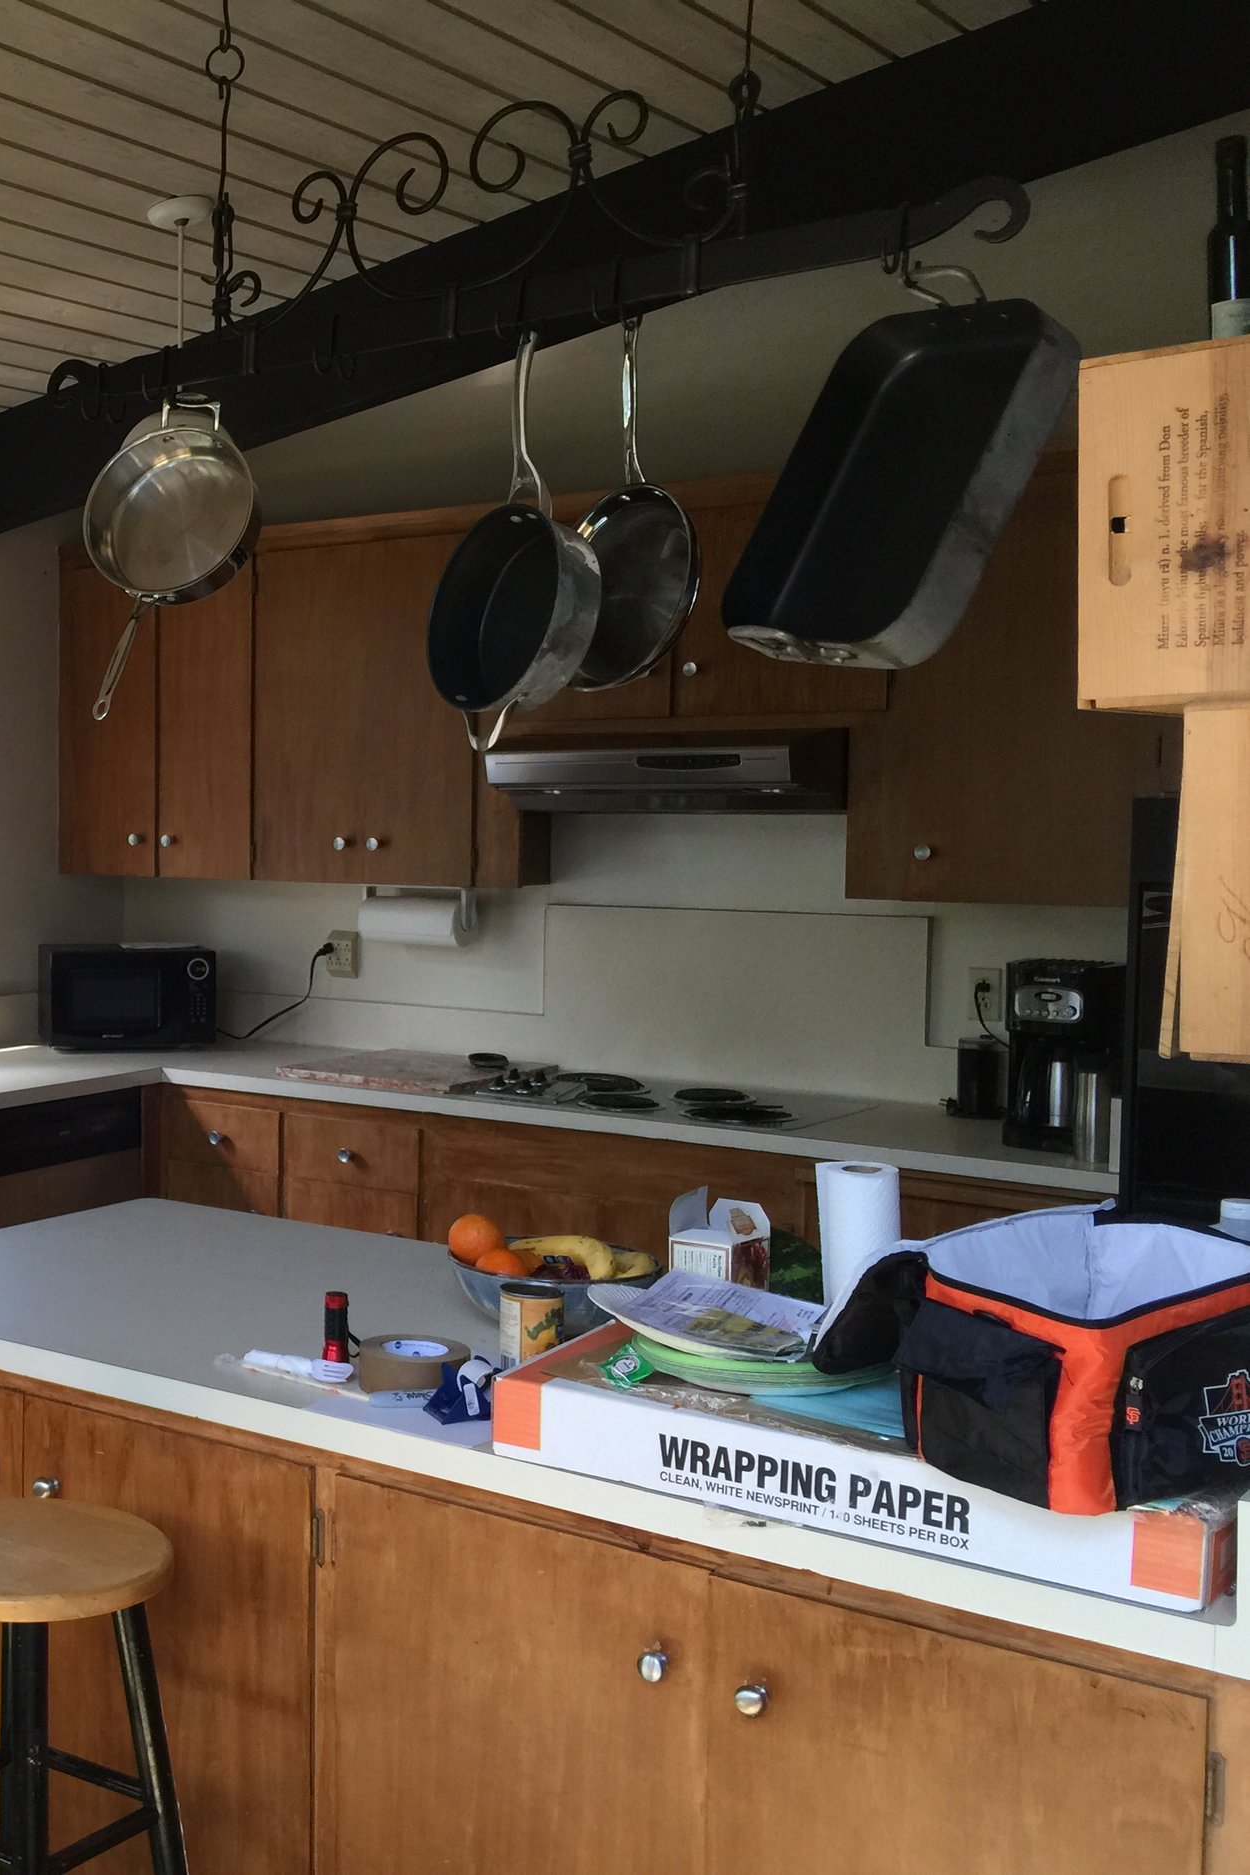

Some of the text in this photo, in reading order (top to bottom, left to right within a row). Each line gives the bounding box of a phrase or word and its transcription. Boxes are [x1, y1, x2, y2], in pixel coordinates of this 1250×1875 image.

[1176, 407, 1189, 419] of
[1158, 425, 1170, 452] Don
[1177, 423, 1189, 464] breeder
[1195, 410, 1211, 459] Spanish,
[1157, 455, 1170, 483] from
[1177, 466, 1188, 506] famous
[1195, 462, 1207, 480] the
[1156, 486, 1170, 526] derived
[1232, 571, 1244, 592] and
[1194, 603, 1210, 648] Spanish
[1223, 1447, 1234, 1458] 20
[659, 1433, 970, 1535] WRAPPING PAPER
[660, 1471, 703, 1491] CLEAN,
[705, 1480, 743, 1499] WHITE
[746, 1490, 820, 1516] NEWSPRINT
[854, 1514, 905, 1536] SHEETS
[909, 1526, 936, 1543] PER
[939, 1534, 970, 1551] BOX
